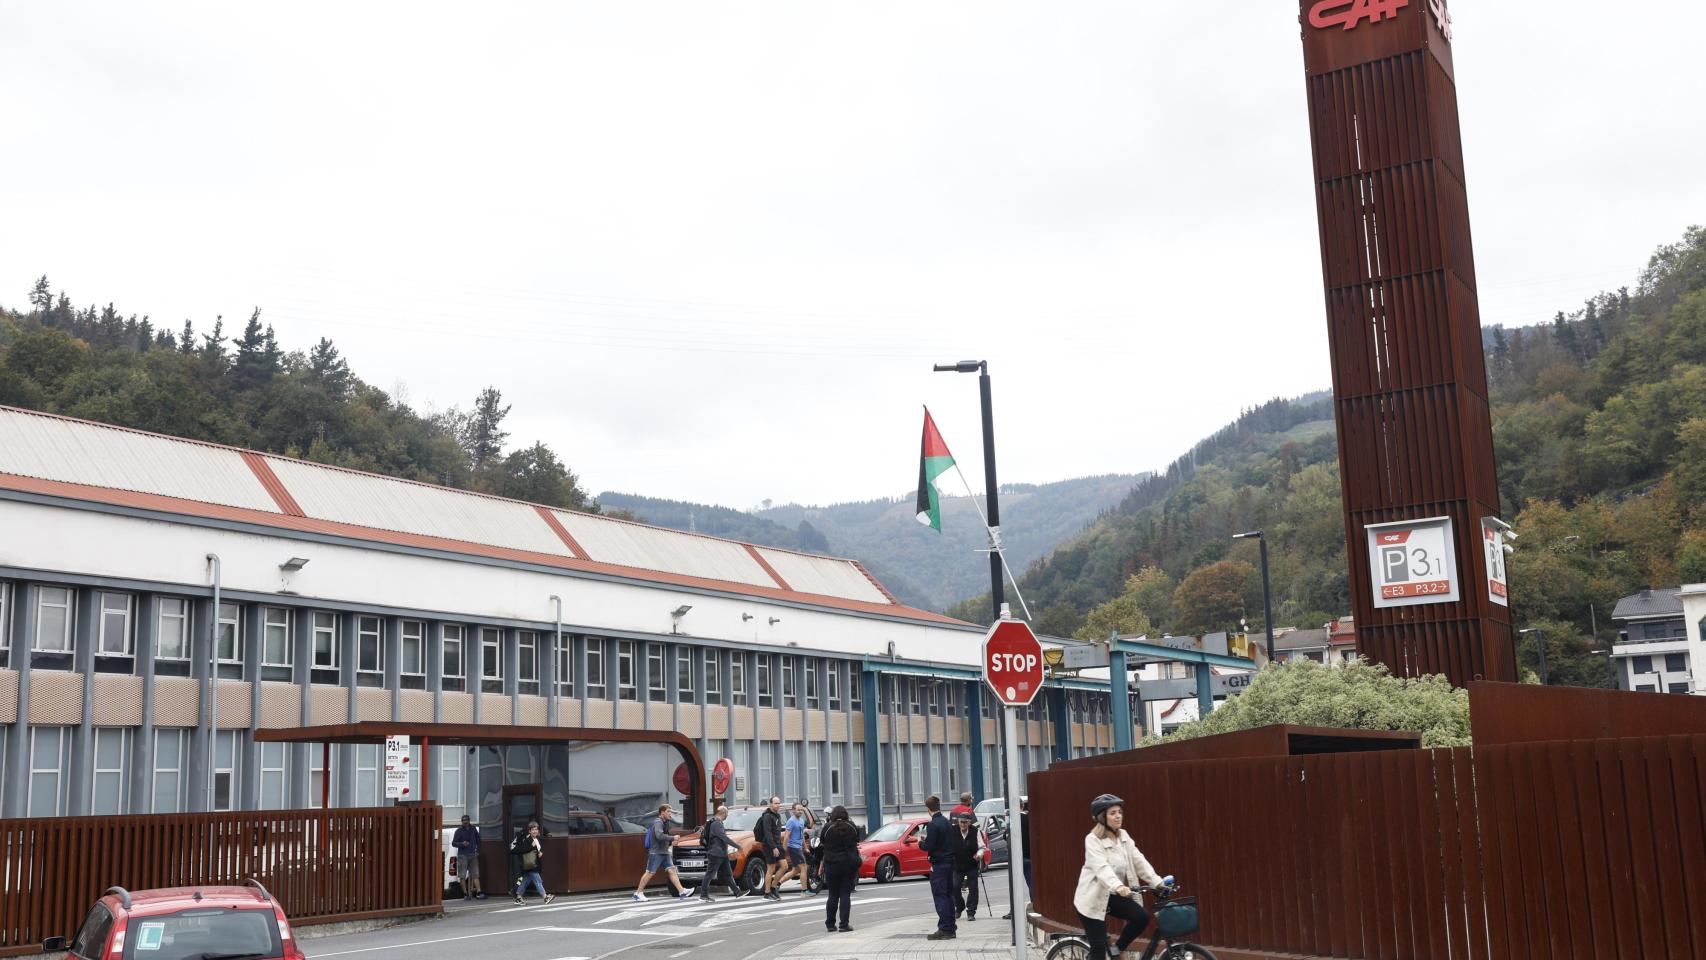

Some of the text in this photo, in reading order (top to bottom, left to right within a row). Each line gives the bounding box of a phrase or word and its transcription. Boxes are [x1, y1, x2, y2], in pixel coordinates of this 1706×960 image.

[1392, 583, 1437, 596] E3 P3.2
[992, 653, 1037, 672] STOP
[388, 740, 400, 751] P3.1
